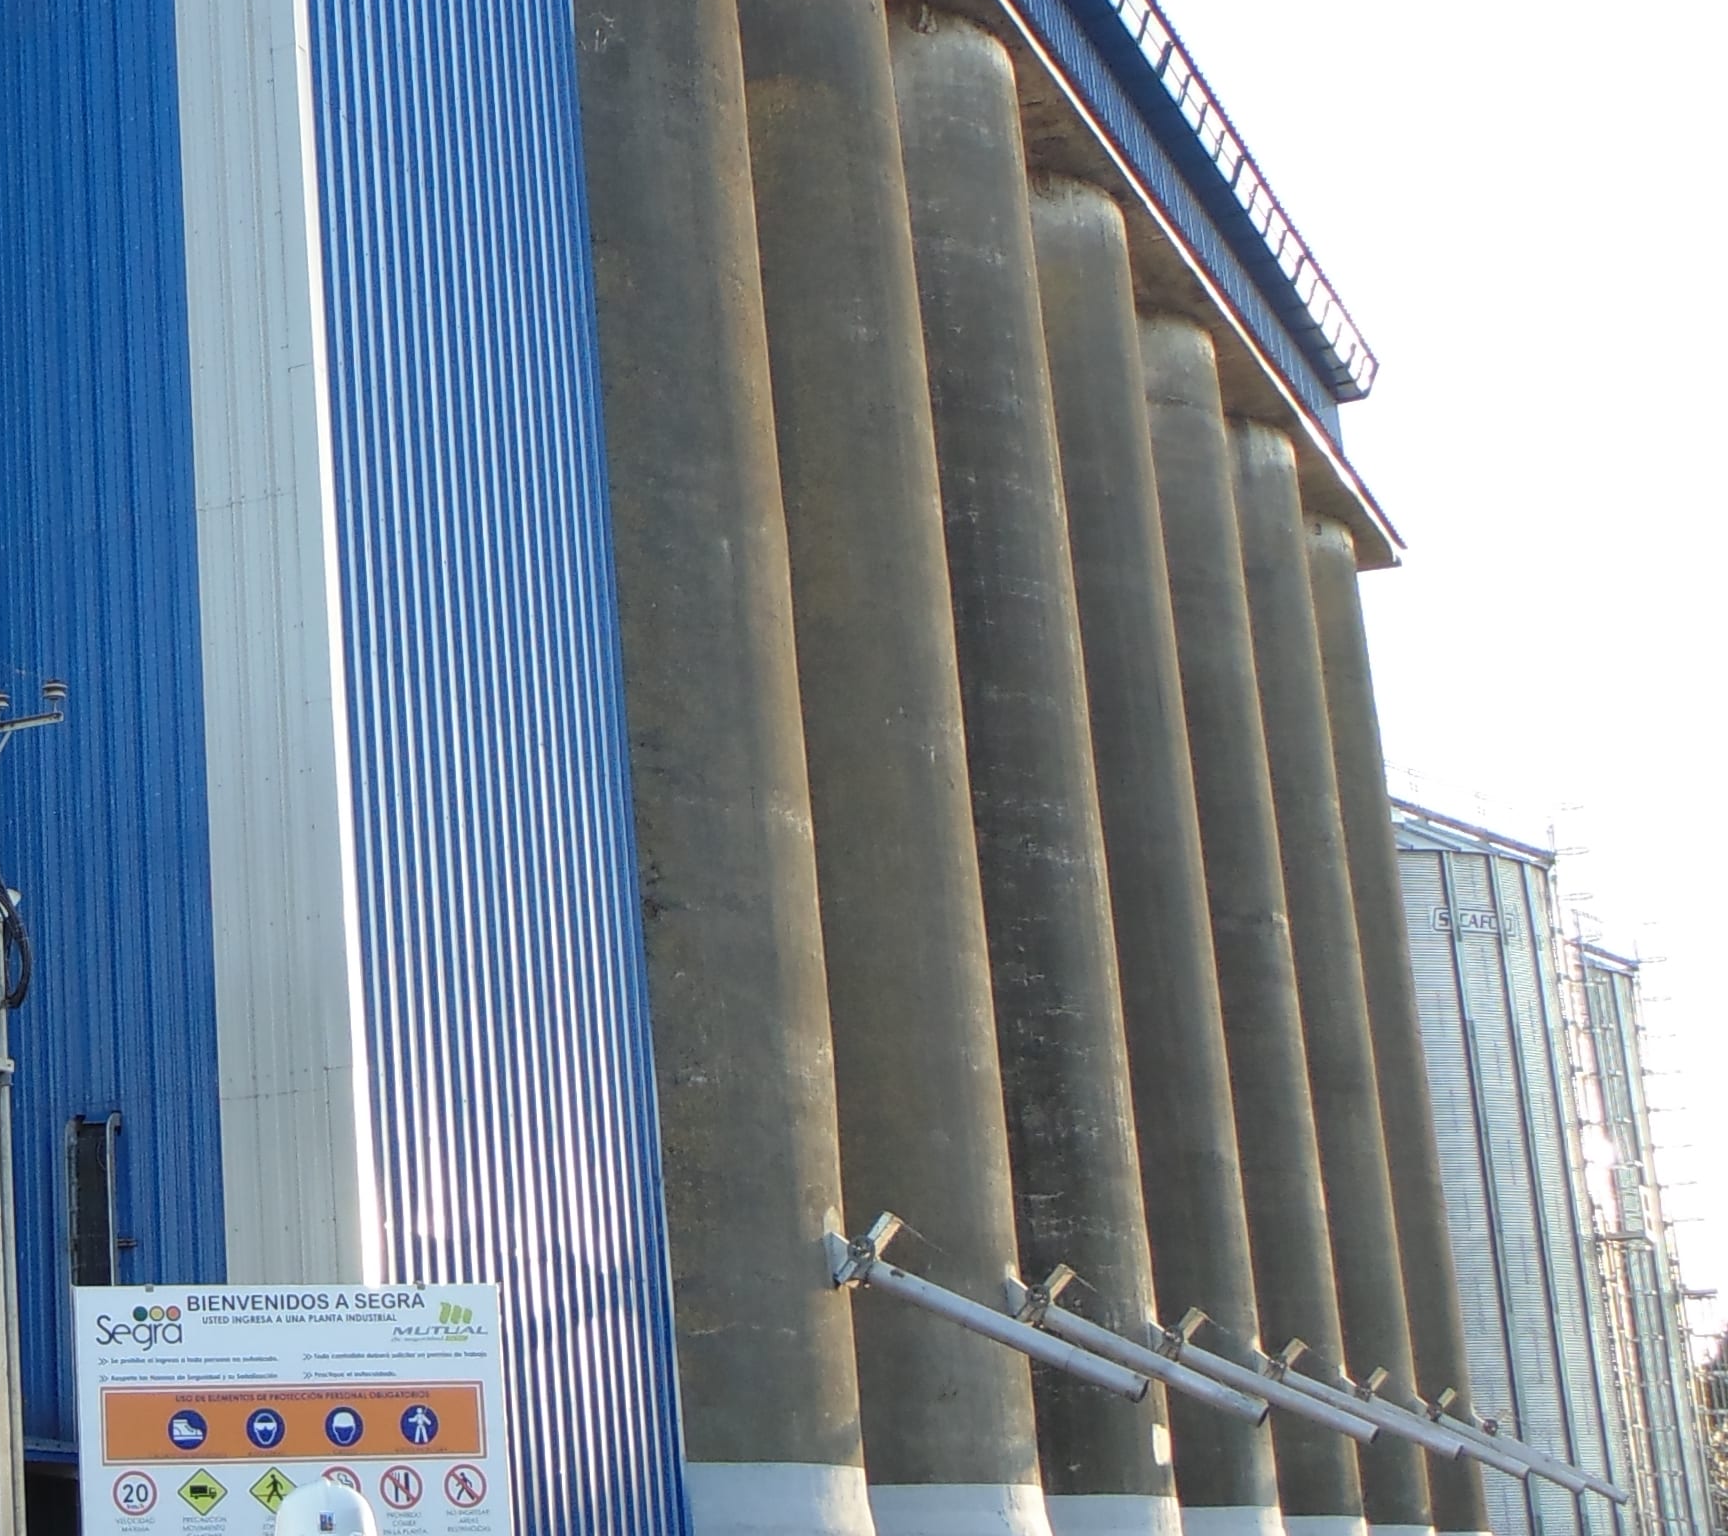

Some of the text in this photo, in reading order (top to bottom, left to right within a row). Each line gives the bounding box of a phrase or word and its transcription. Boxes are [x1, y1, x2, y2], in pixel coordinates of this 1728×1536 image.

[187, 1292, 425, 1312] BIENVENIDOS A SEGRA
[202, 1313, 397, 1324] USTED INGRESA A UNA PLANTA INDUSTRIAL
[96, 1314, 183, 1351] Segra
[393, 1326, 488, 1335] MUTUAL
[175, 1394, 193, 1403] USO
[195, 1394, 206, 1402] DE
[208, 1394, 254, 1402] ELEMENTOS
[256, 1393, 267, 1401] DE
[325, 1391, 367, 1400] PERSONAL
[370, 1390, 430, 1399] OBLIGATORIOS
[123, 1483, 148, 1503] 20
